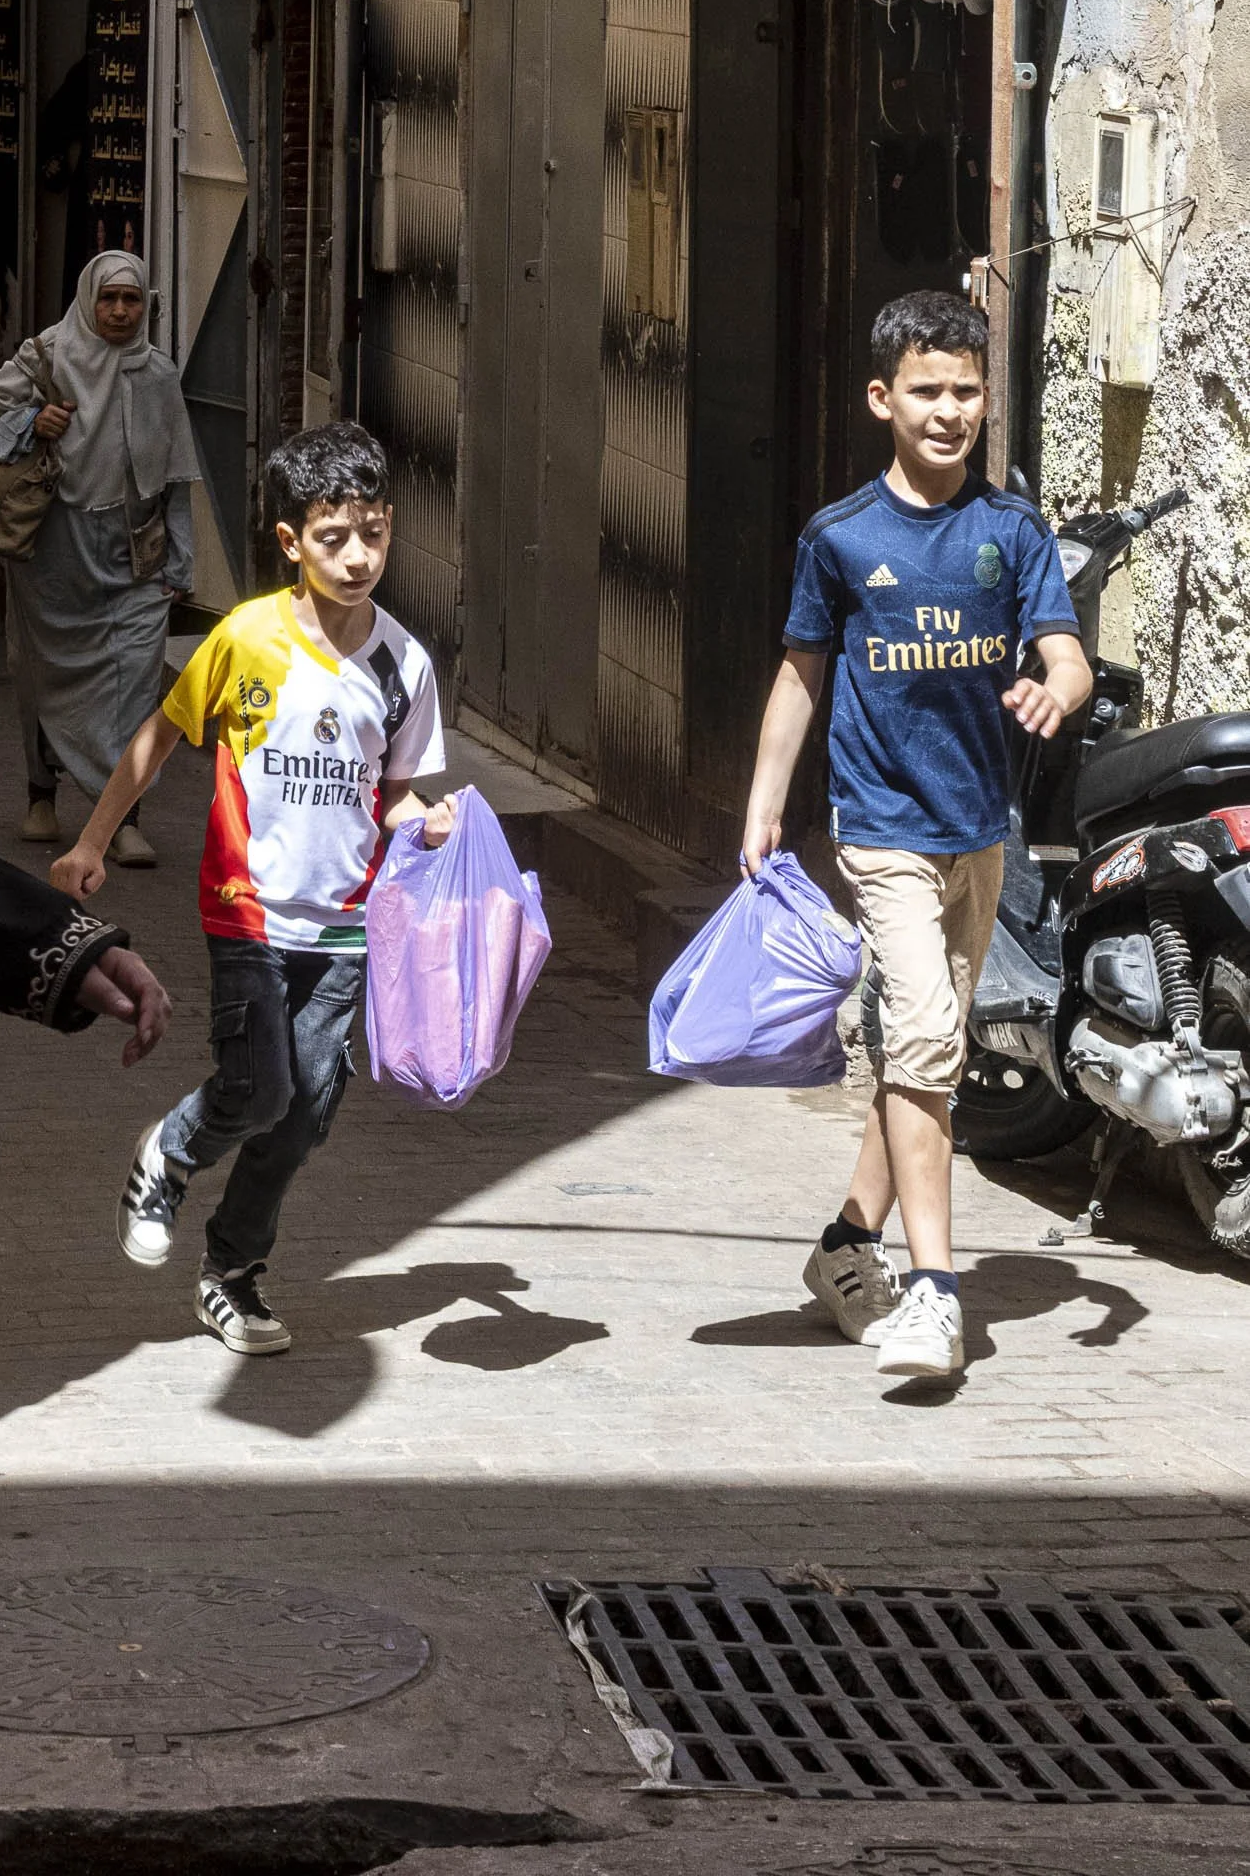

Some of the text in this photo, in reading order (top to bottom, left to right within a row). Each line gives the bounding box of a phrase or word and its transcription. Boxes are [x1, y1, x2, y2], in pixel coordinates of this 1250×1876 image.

[866, 577, 899, 587] adidas
[915, 606, 961, 635] Fly
[865, 633, 1007, 672] Emirates
[262, 747, 371, 784] Emirate
[282, 781, 308, 805] FLY
[987, 1021, 1019, 1049] MBK
